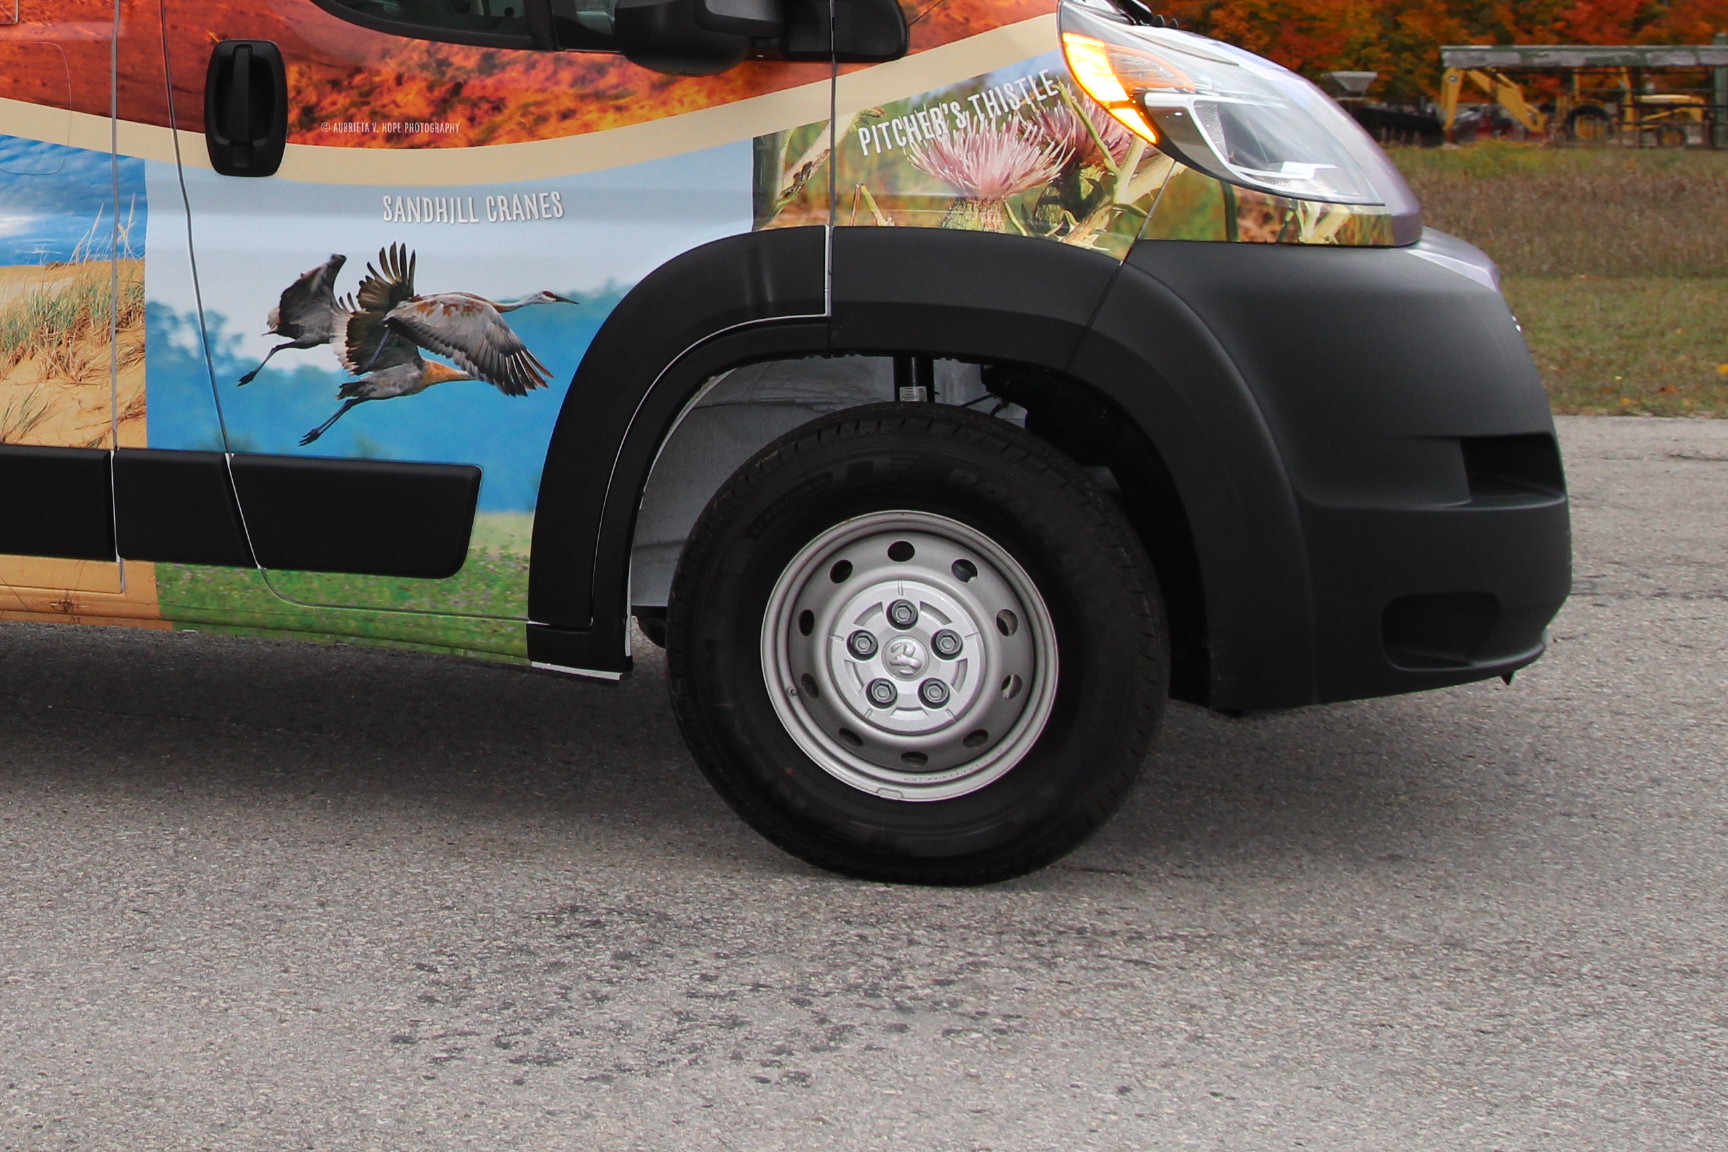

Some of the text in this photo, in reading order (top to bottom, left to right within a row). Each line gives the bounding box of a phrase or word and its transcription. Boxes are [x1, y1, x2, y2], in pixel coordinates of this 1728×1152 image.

[333, 122, 369, 133] AUBRIETA
[382, 122, 401, 133] HOPE
[405, 122, 460, 133] PHOTOGRAPHY
[858, 68, 1059, 156] PITCHER'S THISTLE
[382, 191, 564, 224] SANDHILL CRANES
